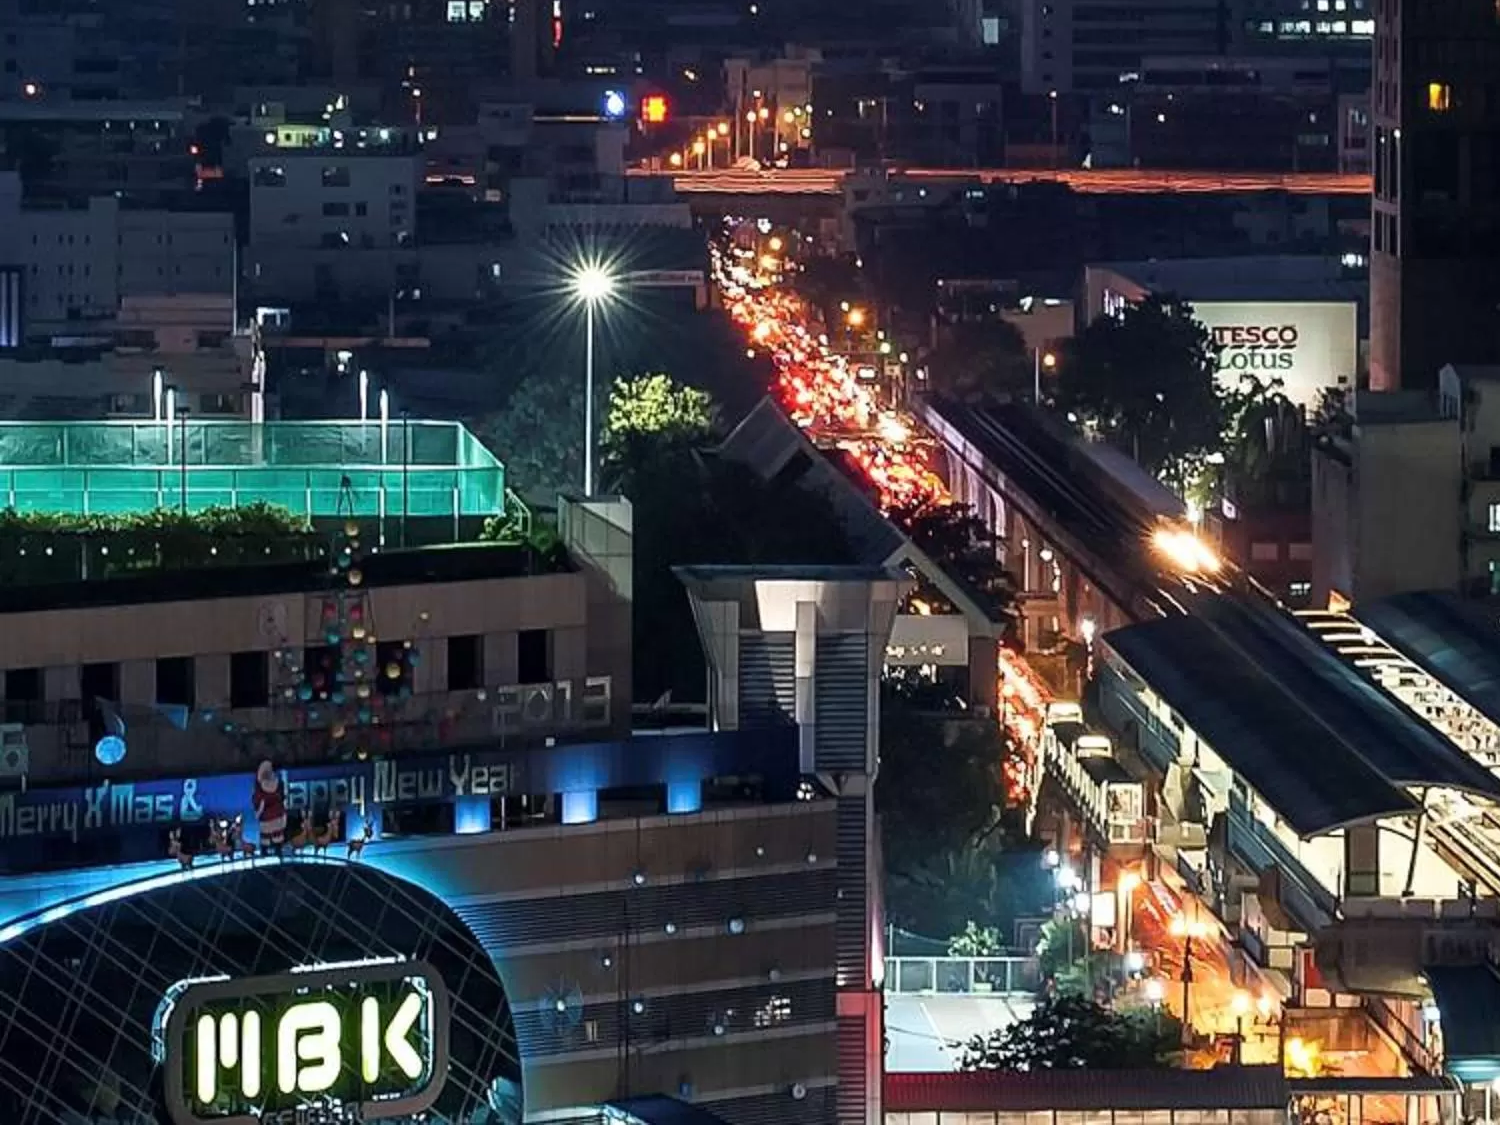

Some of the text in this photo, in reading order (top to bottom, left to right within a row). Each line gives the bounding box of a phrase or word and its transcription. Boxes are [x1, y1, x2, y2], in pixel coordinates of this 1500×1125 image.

[1212, 325, 1298, 344] TESCO
[1215, 348, 1293, 370] Lotus
[180, 778, 203, 822] &
[372, 760, 443, 803] New
[197, 992, 423, 1104] MBK
